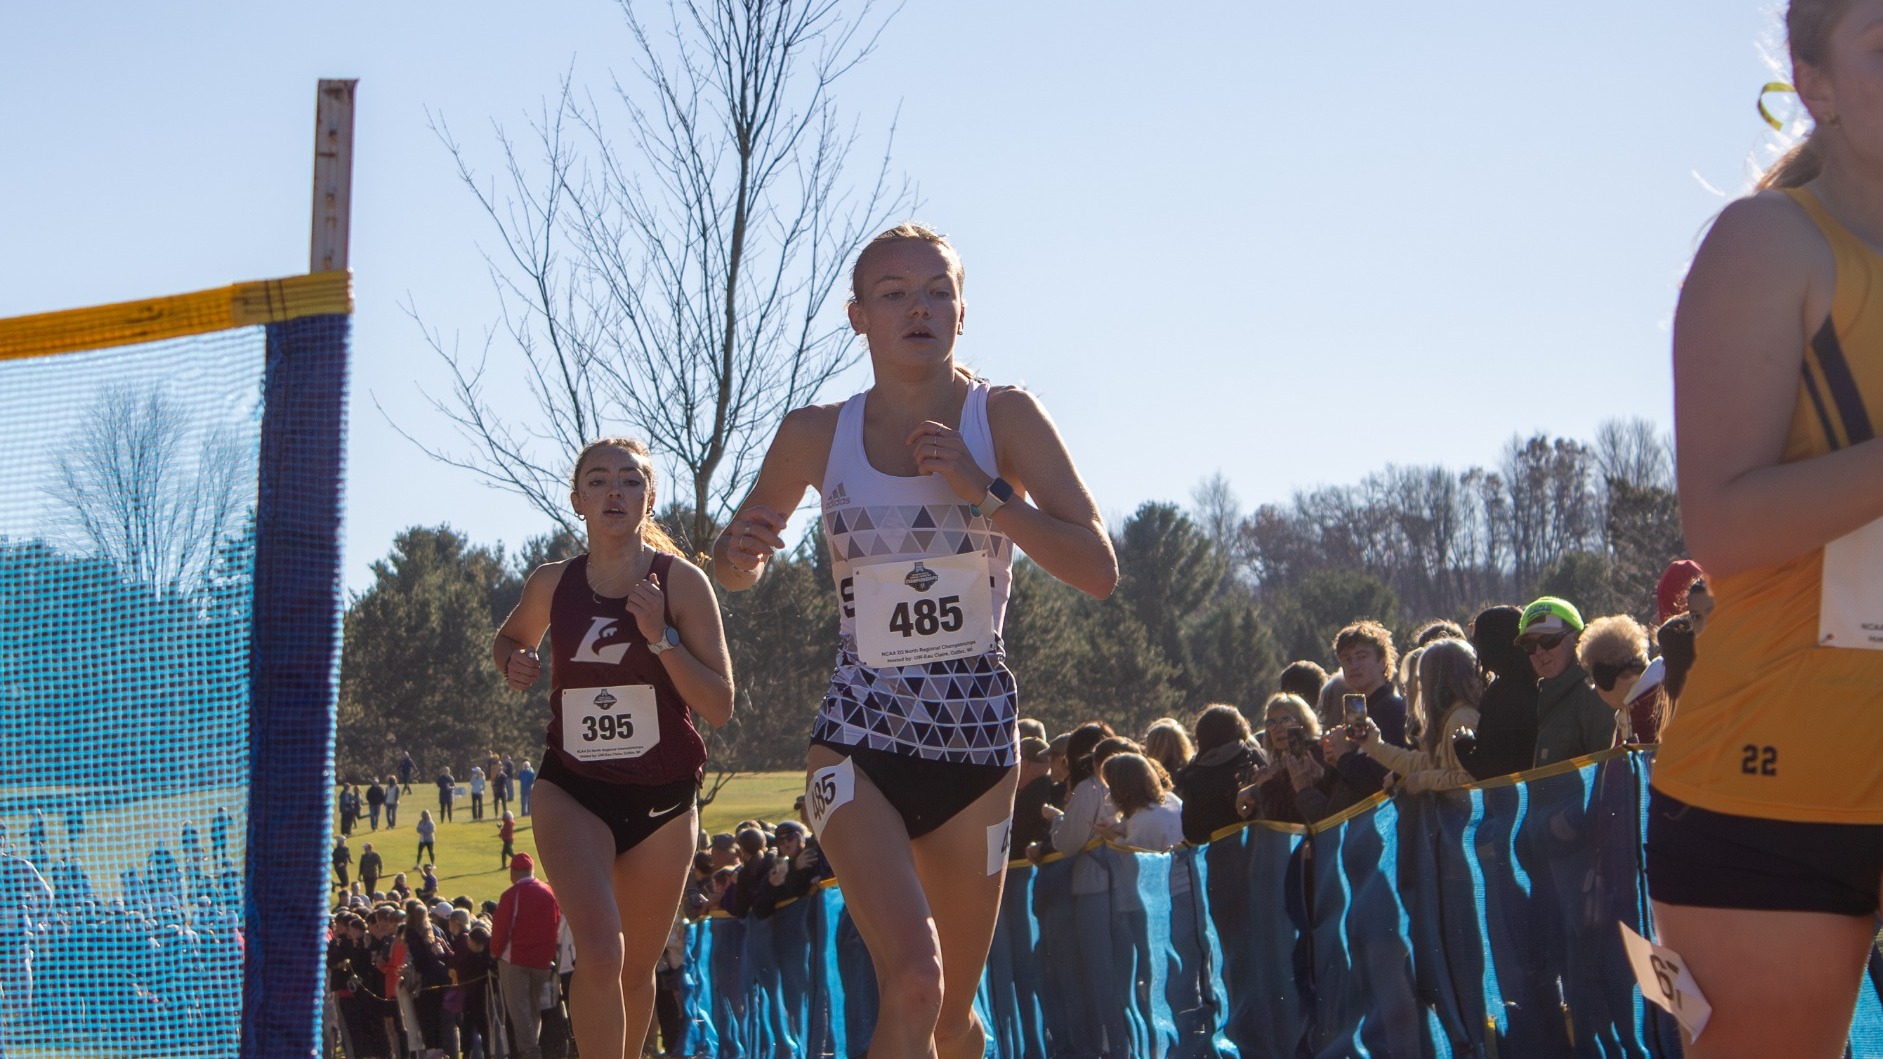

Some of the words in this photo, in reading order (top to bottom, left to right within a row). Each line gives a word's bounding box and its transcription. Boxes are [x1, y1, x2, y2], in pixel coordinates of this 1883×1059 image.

[826, 497, 851, 510] adidas
[889, 595, 963, 637] 485
[942, 640, 976, 649] Championships
[582, 713, 634, 742] 395
[1741, 745, 1778, 776] 22
[812, 773, 836, 821] 485
